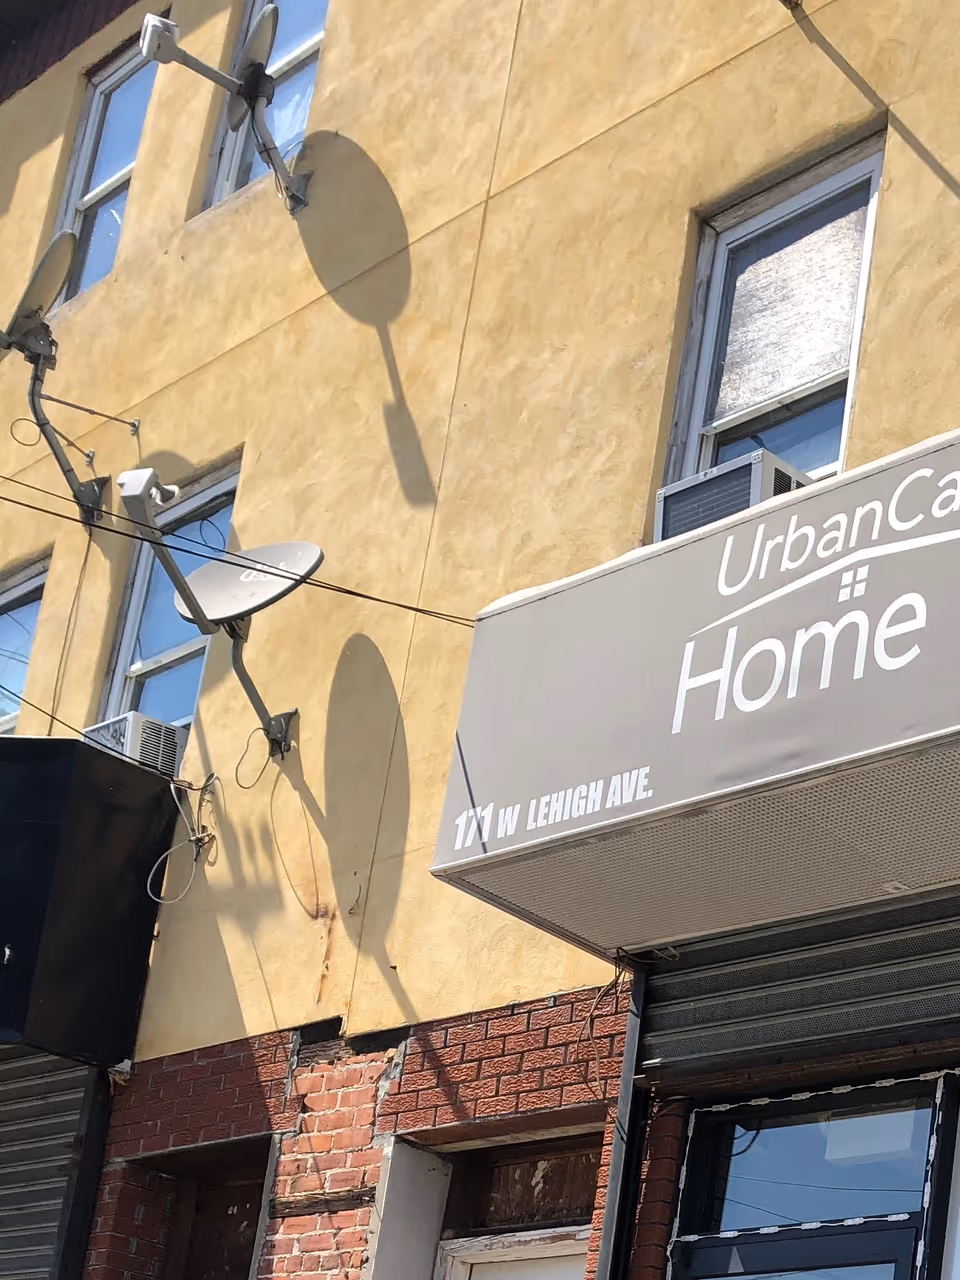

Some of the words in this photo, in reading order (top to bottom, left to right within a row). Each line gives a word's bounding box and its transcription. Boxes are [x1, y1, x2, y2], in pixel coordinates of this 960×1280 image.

[672, 592, 926, 734] Home
[454, 802, 494, 850] 171
[497, 804, 521, 838] W
[526, 779, 604, 830] LEHIGH
[605, 766, 653, 809] AVE.
